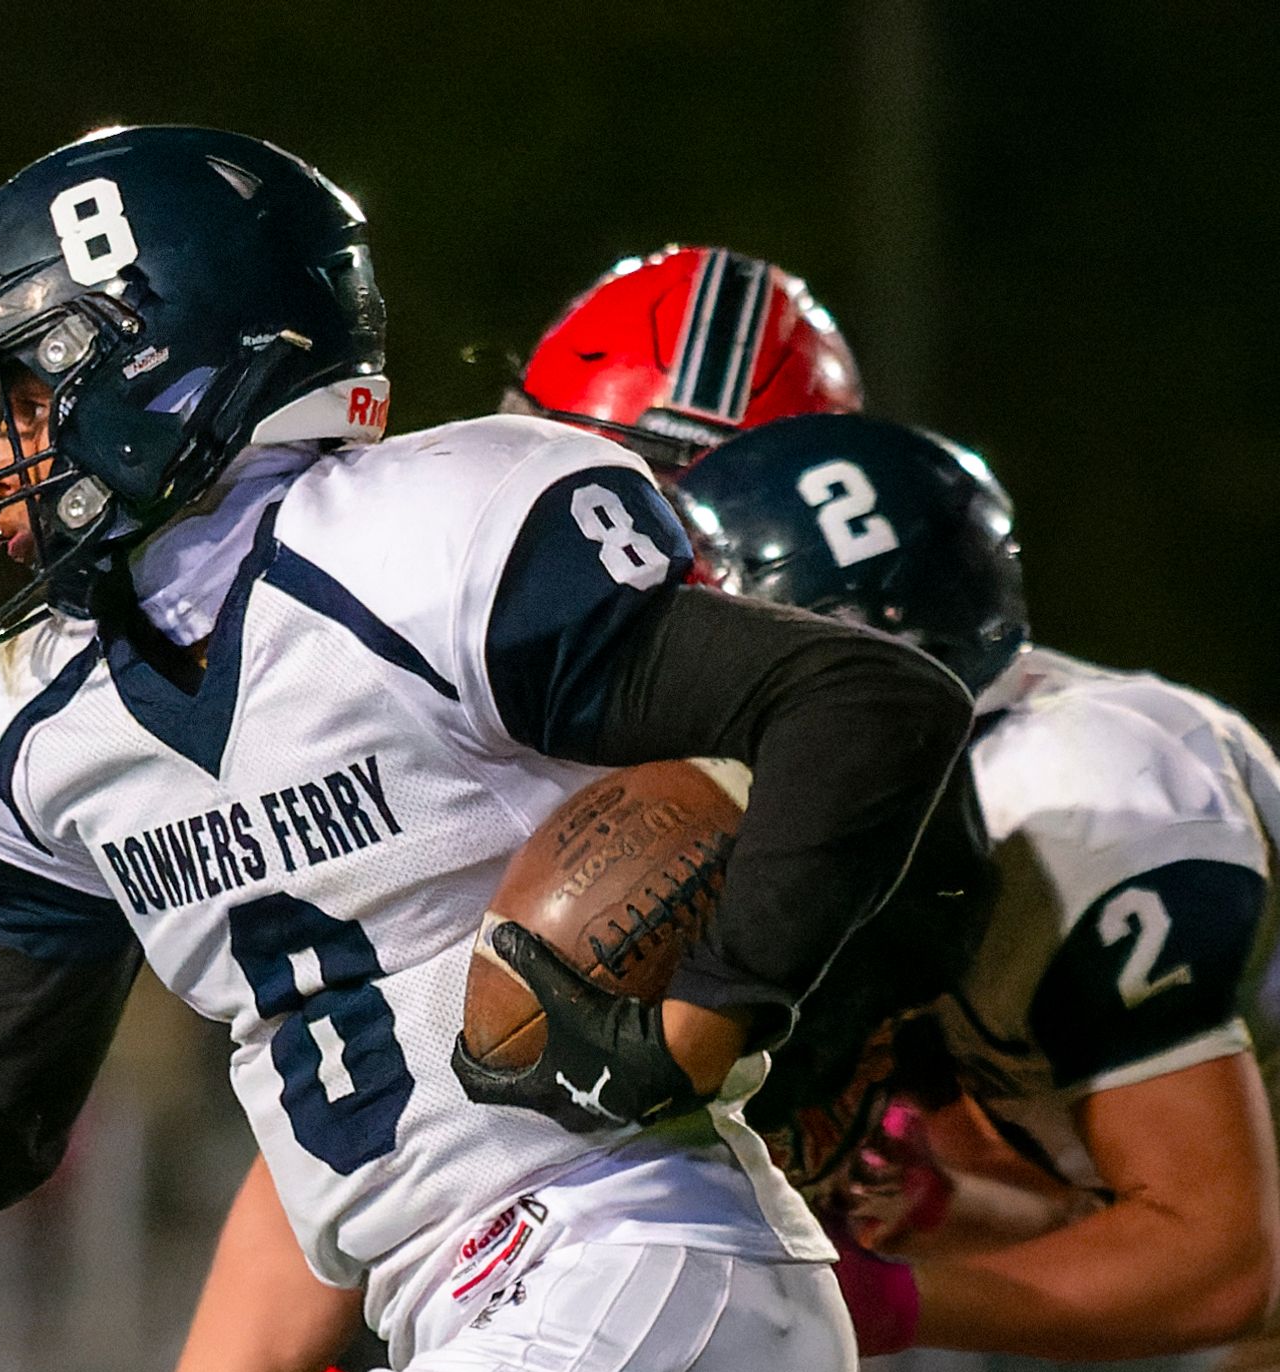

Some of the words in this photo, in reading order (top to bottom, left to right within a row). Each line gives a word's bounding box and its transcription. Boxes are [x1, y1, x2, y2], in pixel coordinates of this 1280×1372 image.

[49, 177, 140, 287] 8
[570, 482, 671, 592] 8
[796, 458, 900, 568] 2
[101, 801, 267, 915] BONNERS
[259, 754, 404, 873] FERRY
[1096, 886, 1191, 1009] 2
[228, 891, 416, 1177] 8
